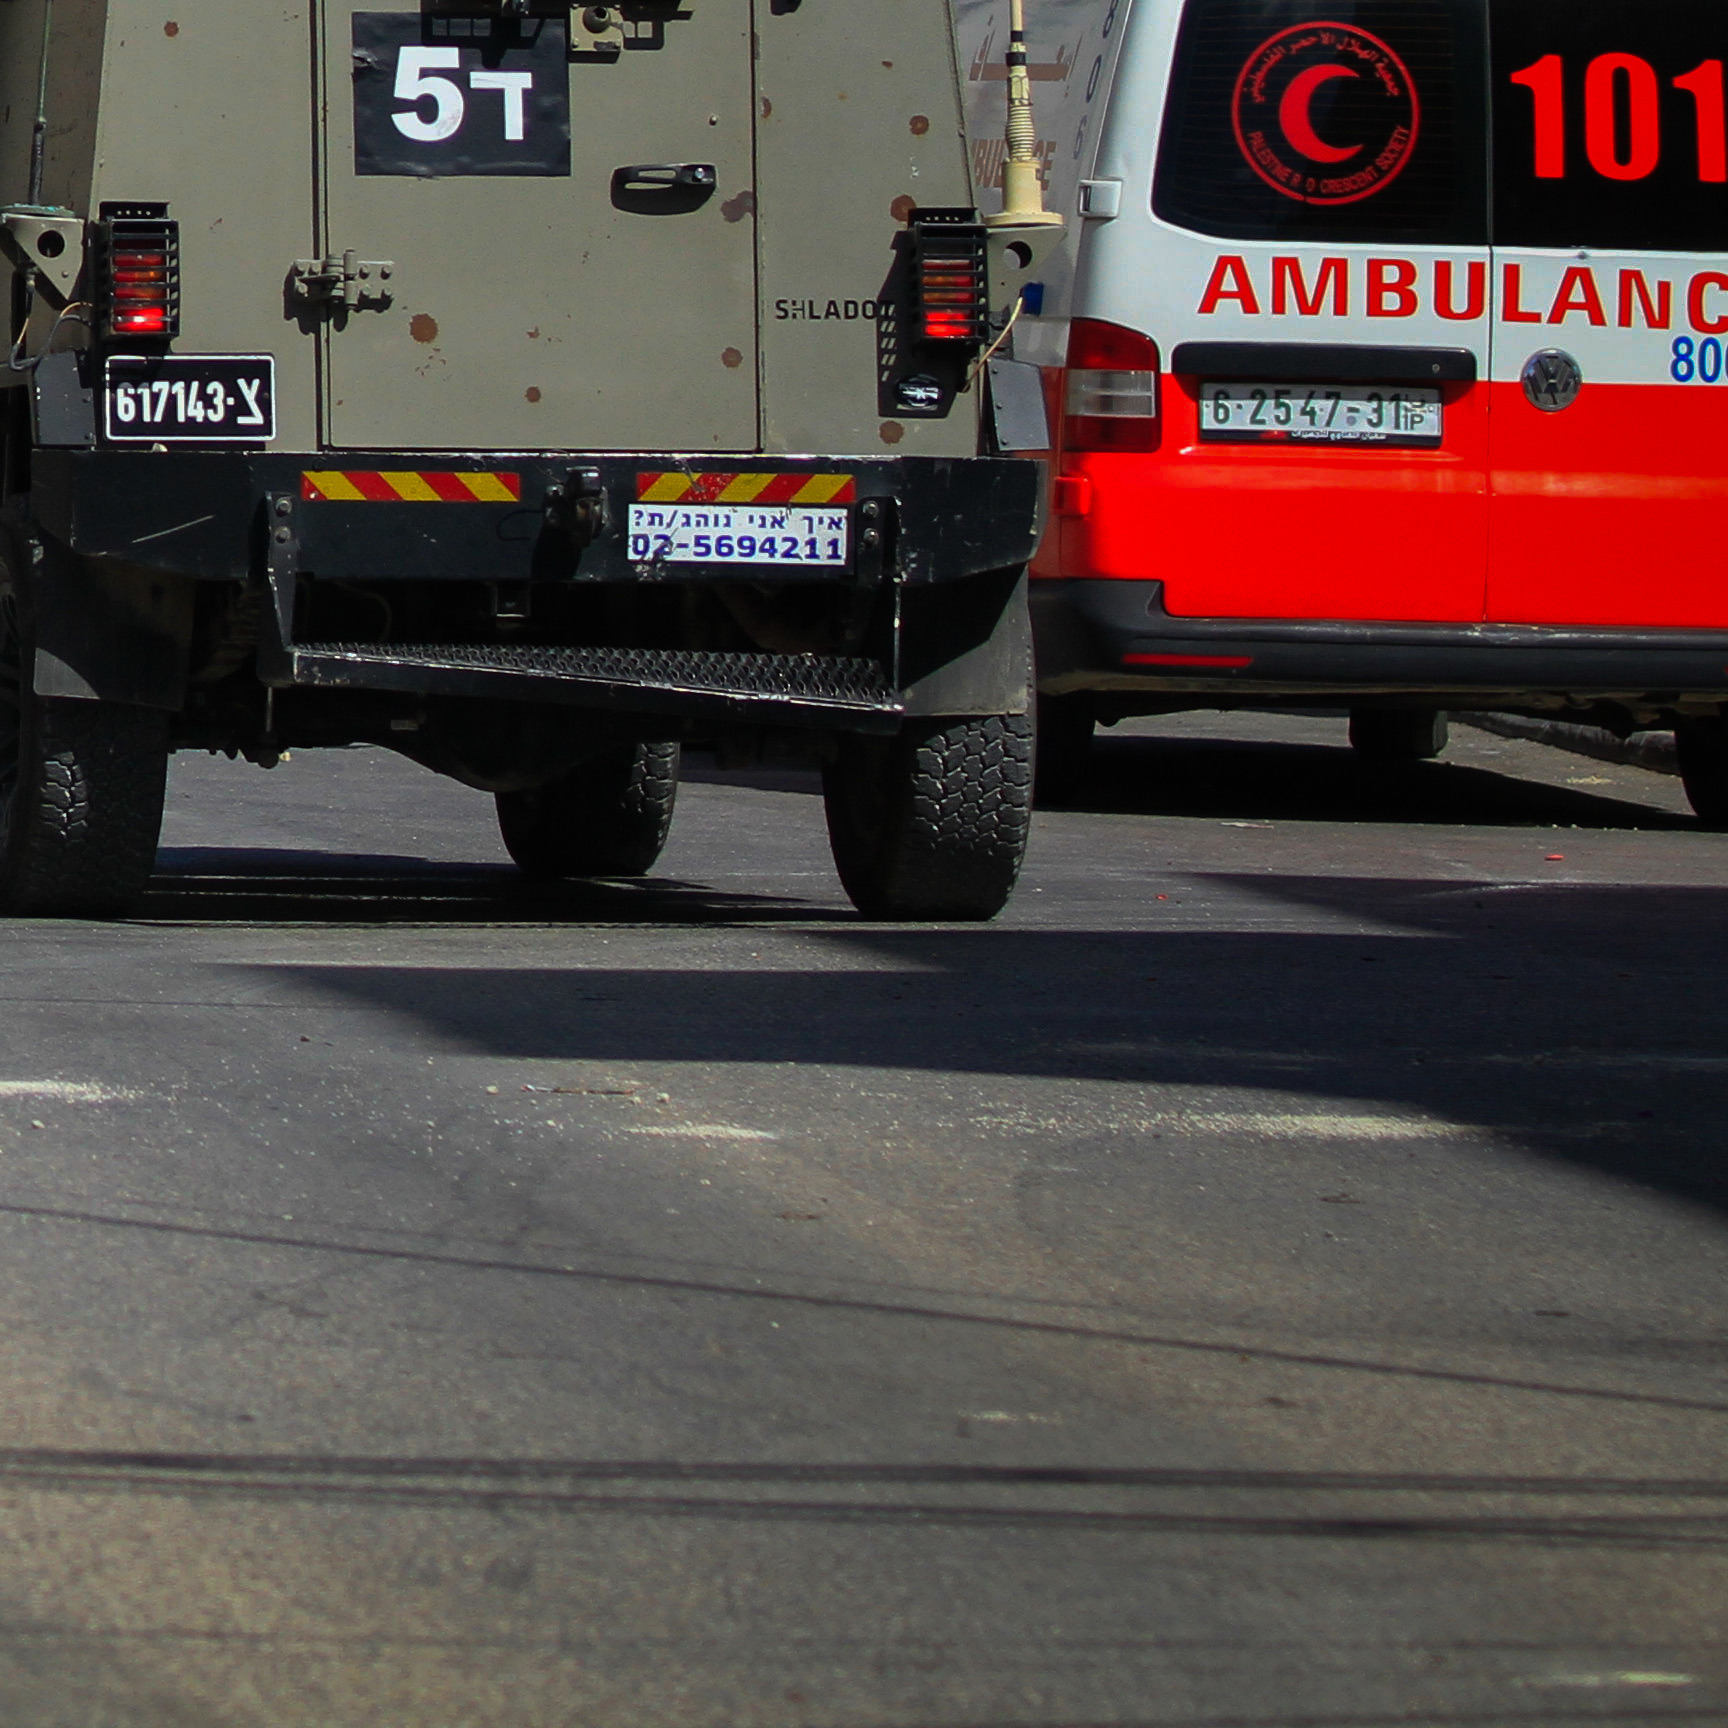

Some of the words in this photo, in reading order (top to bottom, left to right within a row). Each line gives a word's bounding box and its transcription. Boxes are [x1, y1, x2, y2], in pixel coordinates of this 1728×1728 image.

[1510, 51, 1728, 184] 101
[1246, 129, 1292, 186] PALESTINE
[1319, 164, 1380, 194] CRESCENT
[1374, 123, 1411, 171] SOCIETY
[1671, 335, 1728, 383] 80
[748, 513, 787, 530] אני
[802, 514, 844, 534] איך
[631, 533, 843, 560] 02-5694211
